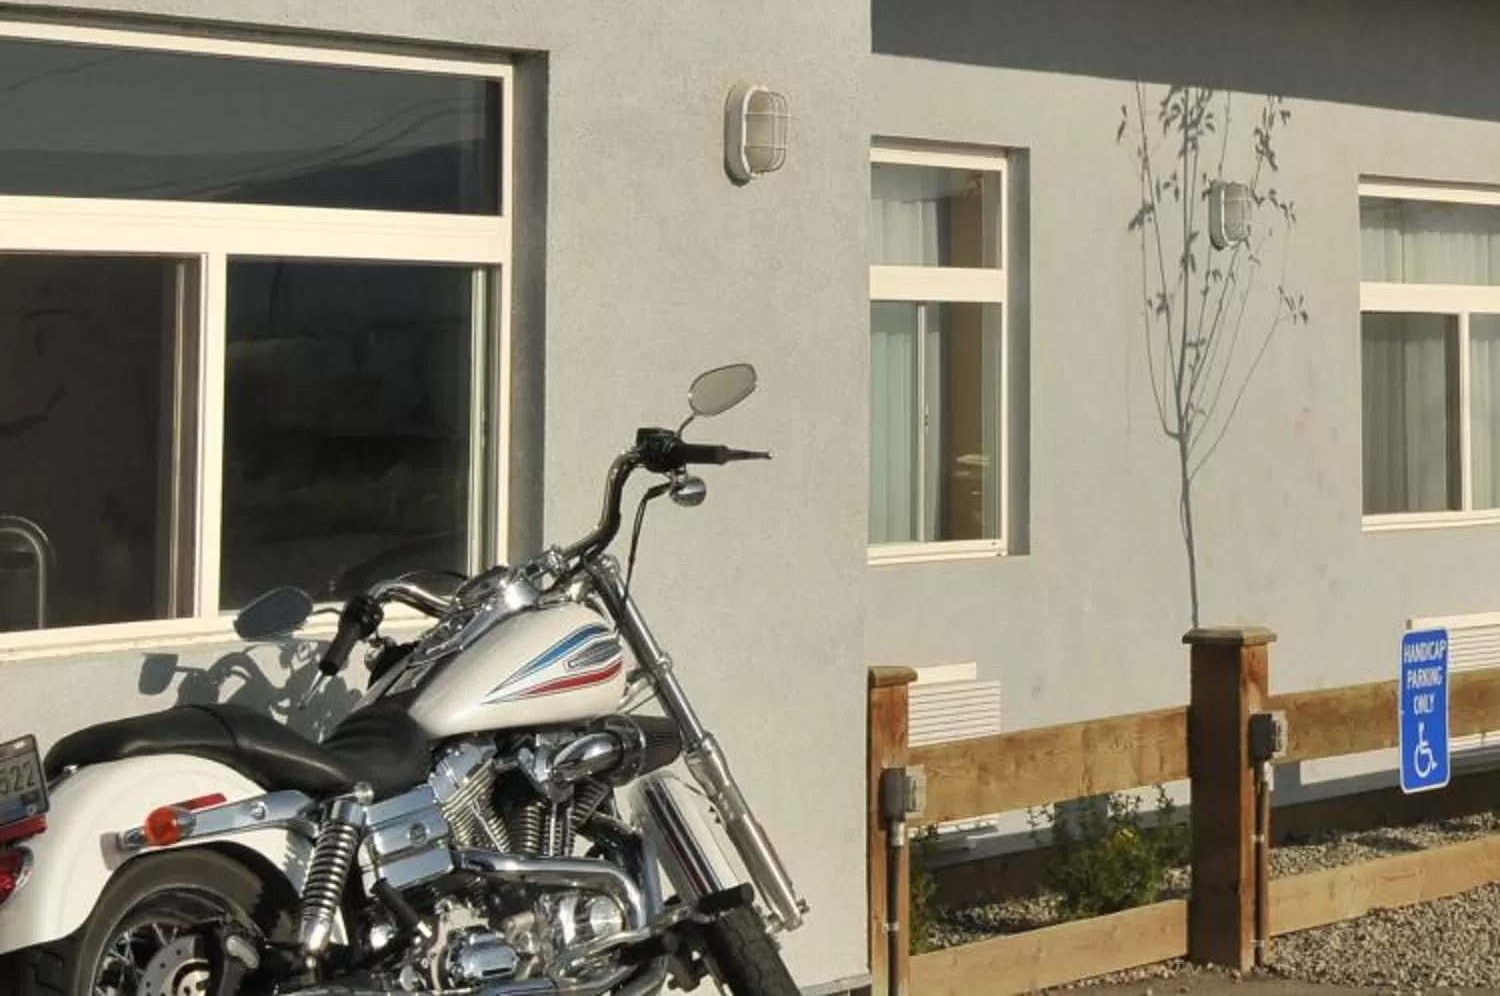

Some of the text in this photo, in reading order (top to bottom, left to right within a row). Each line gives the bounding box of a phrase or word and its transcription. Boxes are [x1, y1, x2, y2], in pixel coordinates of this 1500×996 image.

[1403, 640, 1447, 663] HANDICAP
[1407, 666, 1443, 689] PARKING
[1413, 694, 1435, 715] ONLY
